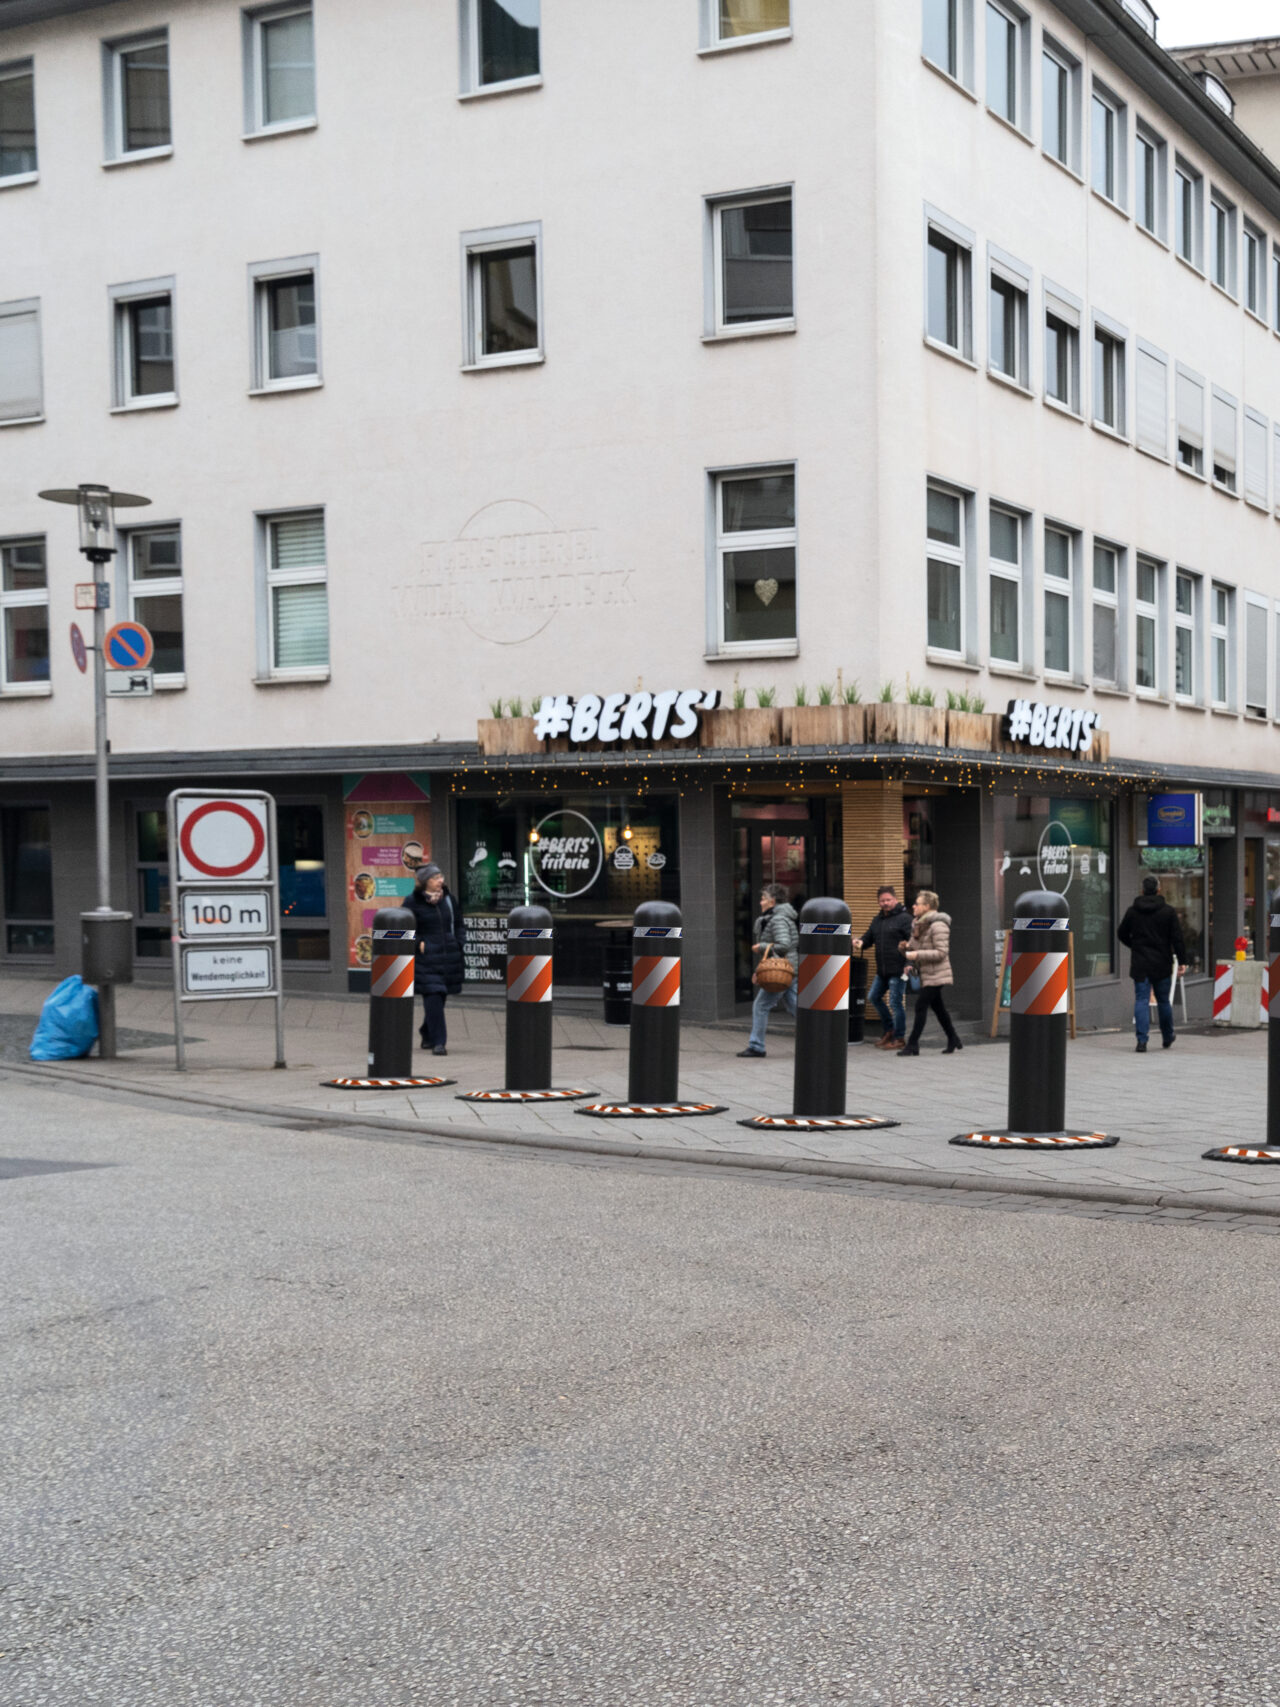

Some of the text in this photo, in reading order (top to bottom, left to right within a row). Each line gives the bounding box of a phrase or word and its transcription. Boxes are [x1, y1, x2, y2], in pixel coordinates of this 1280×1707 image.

[541, 853, 590, 870] friterie
[192, 904, 261, 924] 100 m
[463, 943, 508, 955] GLUTENFRE
[213, 955, 243, 965] keine
[464, 955, 489, 968] VEGAN
[464, 968, 504, 981] REGIONAL
